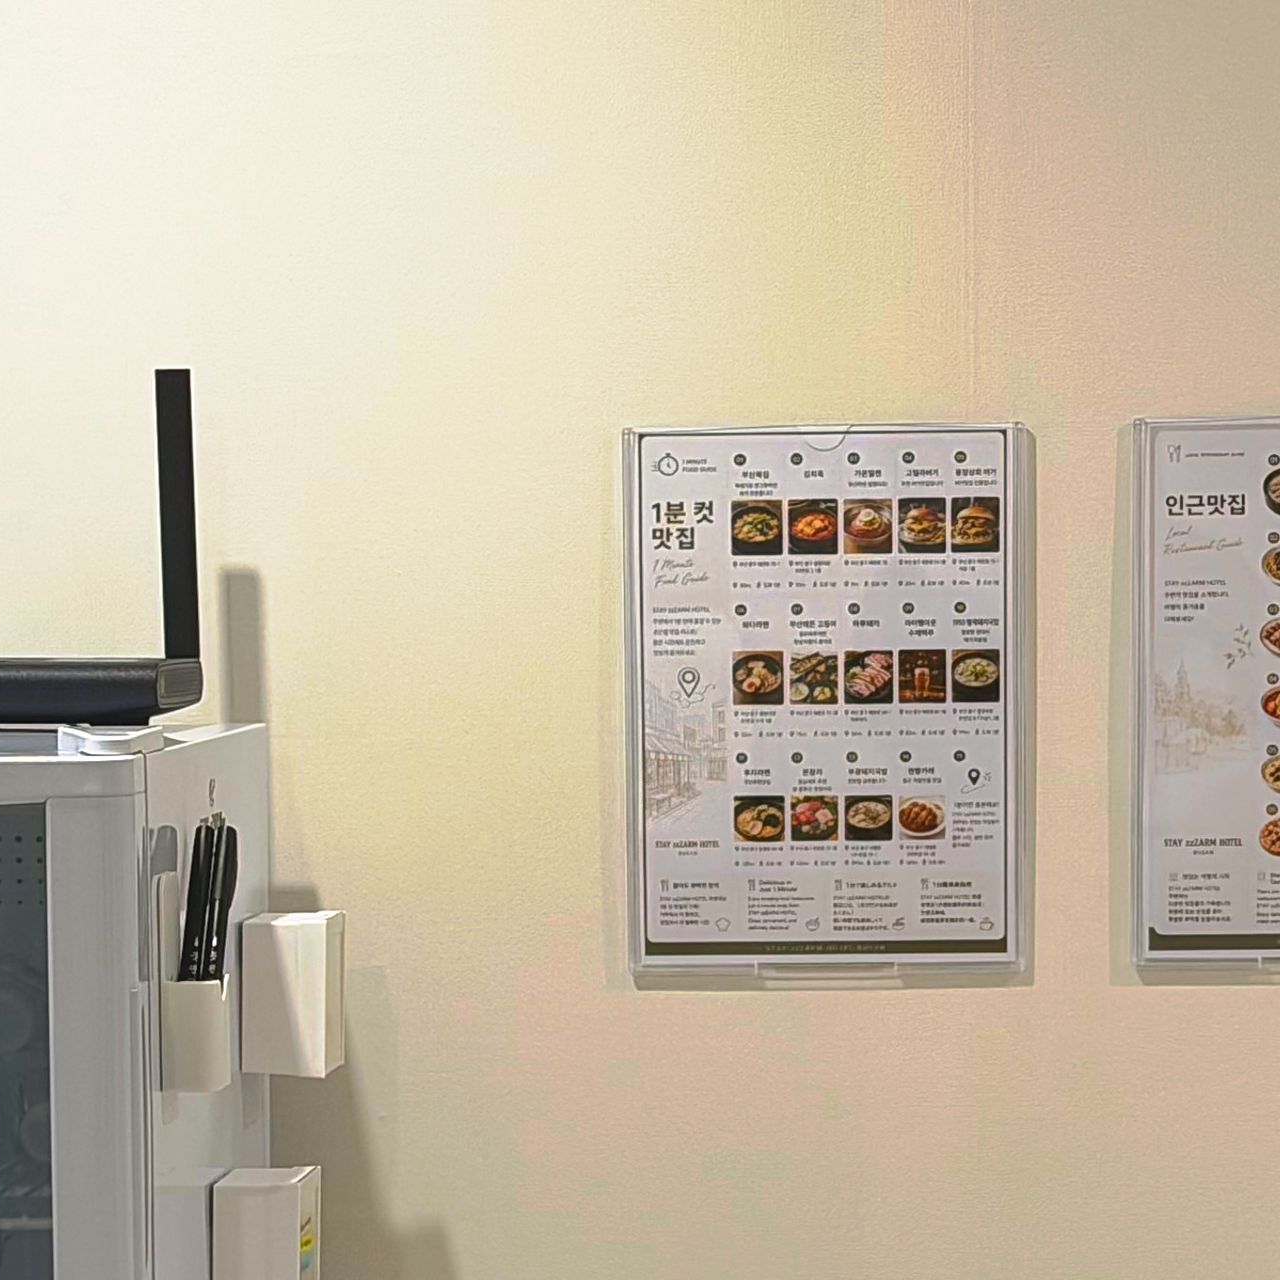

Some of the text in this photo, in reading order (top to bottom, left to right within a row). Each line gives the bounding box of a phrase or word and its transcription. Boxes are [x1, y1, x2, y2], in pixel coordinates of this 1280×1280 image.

[651, 500, 714, 524] 1분 컷
[1166, 494, 1246, 516] 인근맛집
[652, 527, 695, 550] 맛집
[1164, 838, 1183, 847] STAY
[1219, 838, 1243, 847] HOTEL
